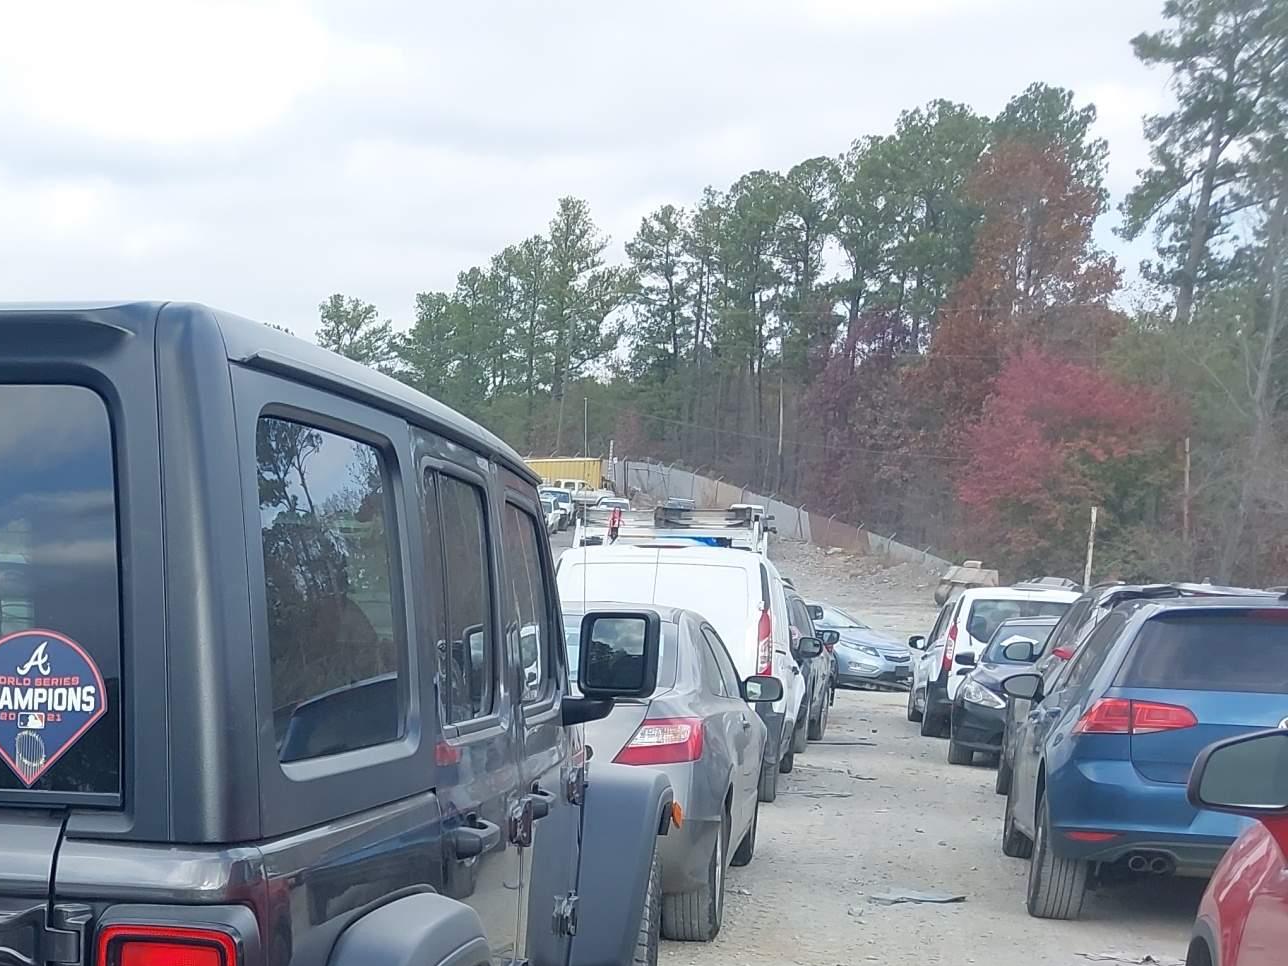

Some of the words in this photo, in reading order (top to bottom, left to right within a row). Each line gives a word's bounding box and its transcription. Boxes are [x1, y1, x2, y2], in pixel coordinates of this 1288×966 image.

[34, 676, 80, 687] SERIES
[0, 711, 16, 721] 20
[47, 712, 62, 722] 21
